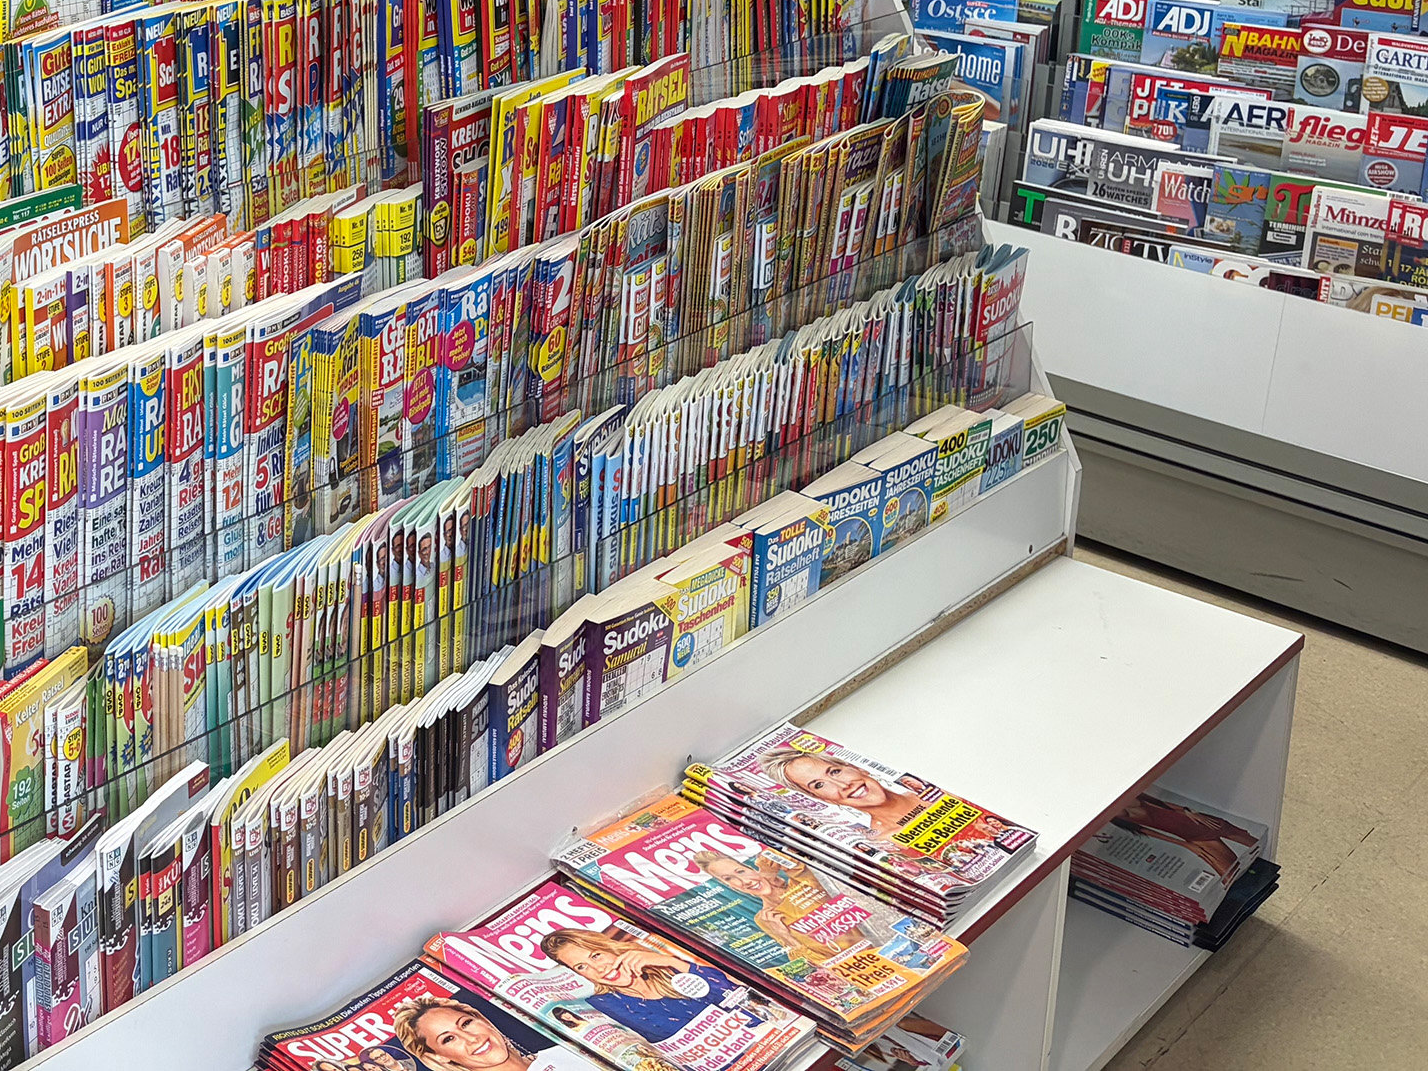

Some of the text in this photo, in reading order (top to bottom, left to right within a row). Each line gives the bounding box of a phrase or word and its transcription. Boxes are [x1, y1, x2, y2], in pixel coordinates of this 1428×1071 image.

[928, 0, 997, 22] Ostsee
[1157, 5, 1212, 37] ADJ
[1026, 418, 1059, 457] 250
[885, 466, 935, 499] JAHRESZEITEN
[678, 596, 735, 633] Taschenheft
[603, 613, 670, 655] Sudoku
[603, 638, 648, 672] Samurai
[895, 797, 961, 844] Überraschende
[913, 806, 979, 854] Sex-Beichte!
[600, 820, 763, 903] Meins
[813, 893, 855, 924] bleiben
[444, 891, 613, 979] Meins
[286, 1015, 389, 1065] SUPER
[721, 1029, 756, 1061] Hand
